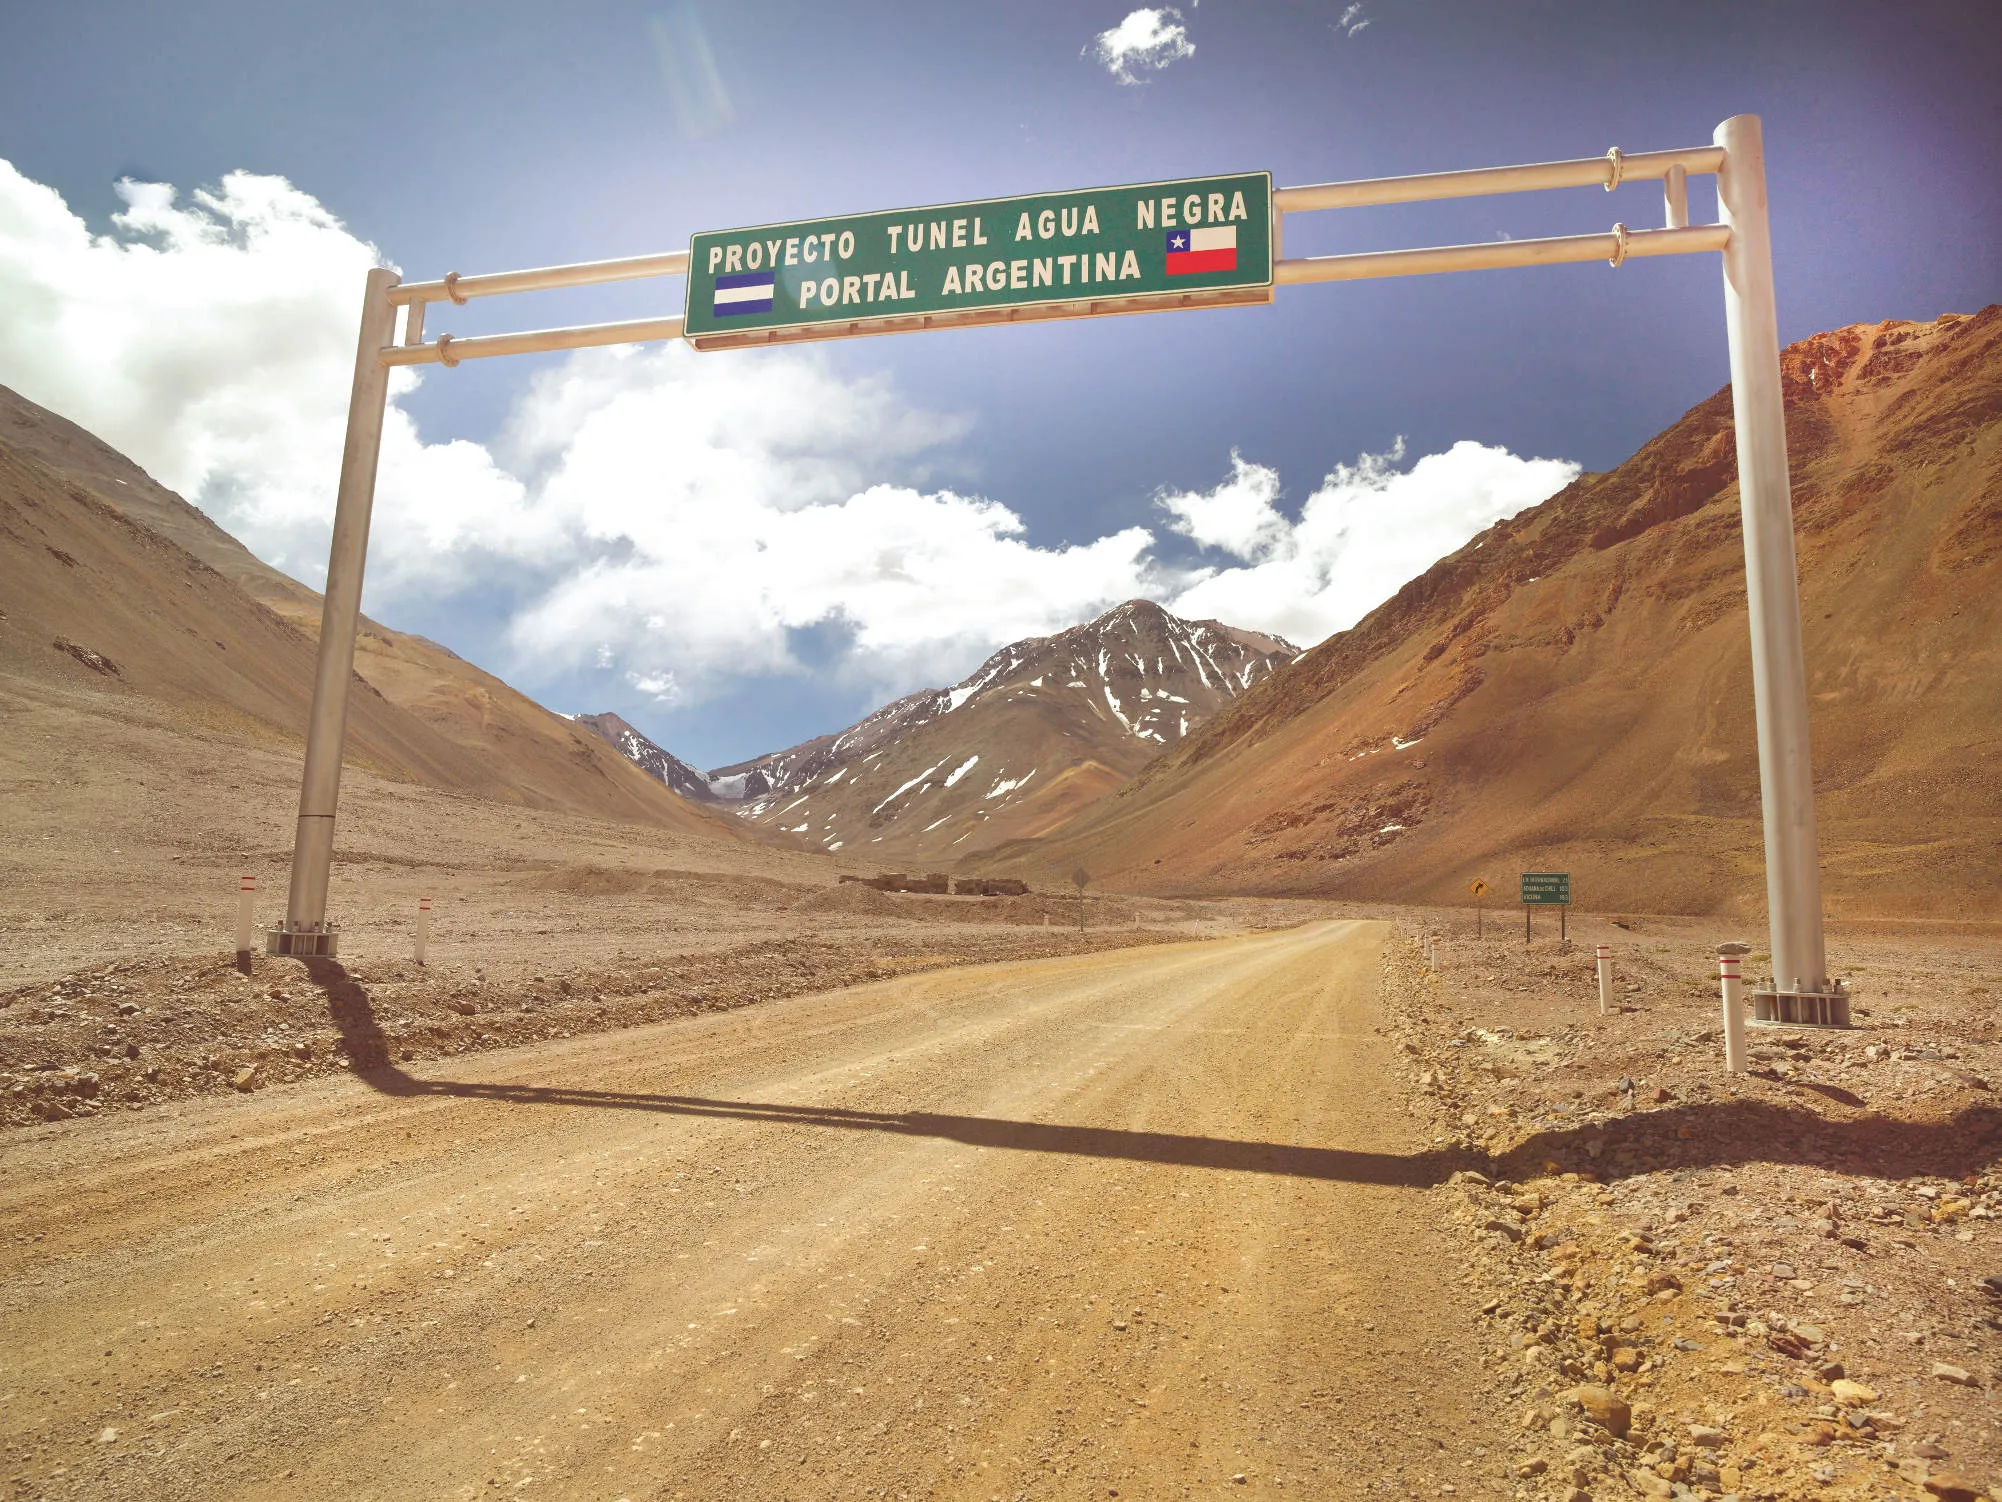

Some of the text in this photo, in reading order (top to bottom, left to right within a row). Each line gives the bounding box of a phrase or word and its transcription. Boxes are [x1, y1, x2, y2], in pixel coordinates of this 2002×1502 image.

[708, 190, 1248, 274] PROYECTO TUNEL AGUA NEGRA
[799, 249, 1142, 310] PORTAL ARGENTINA
